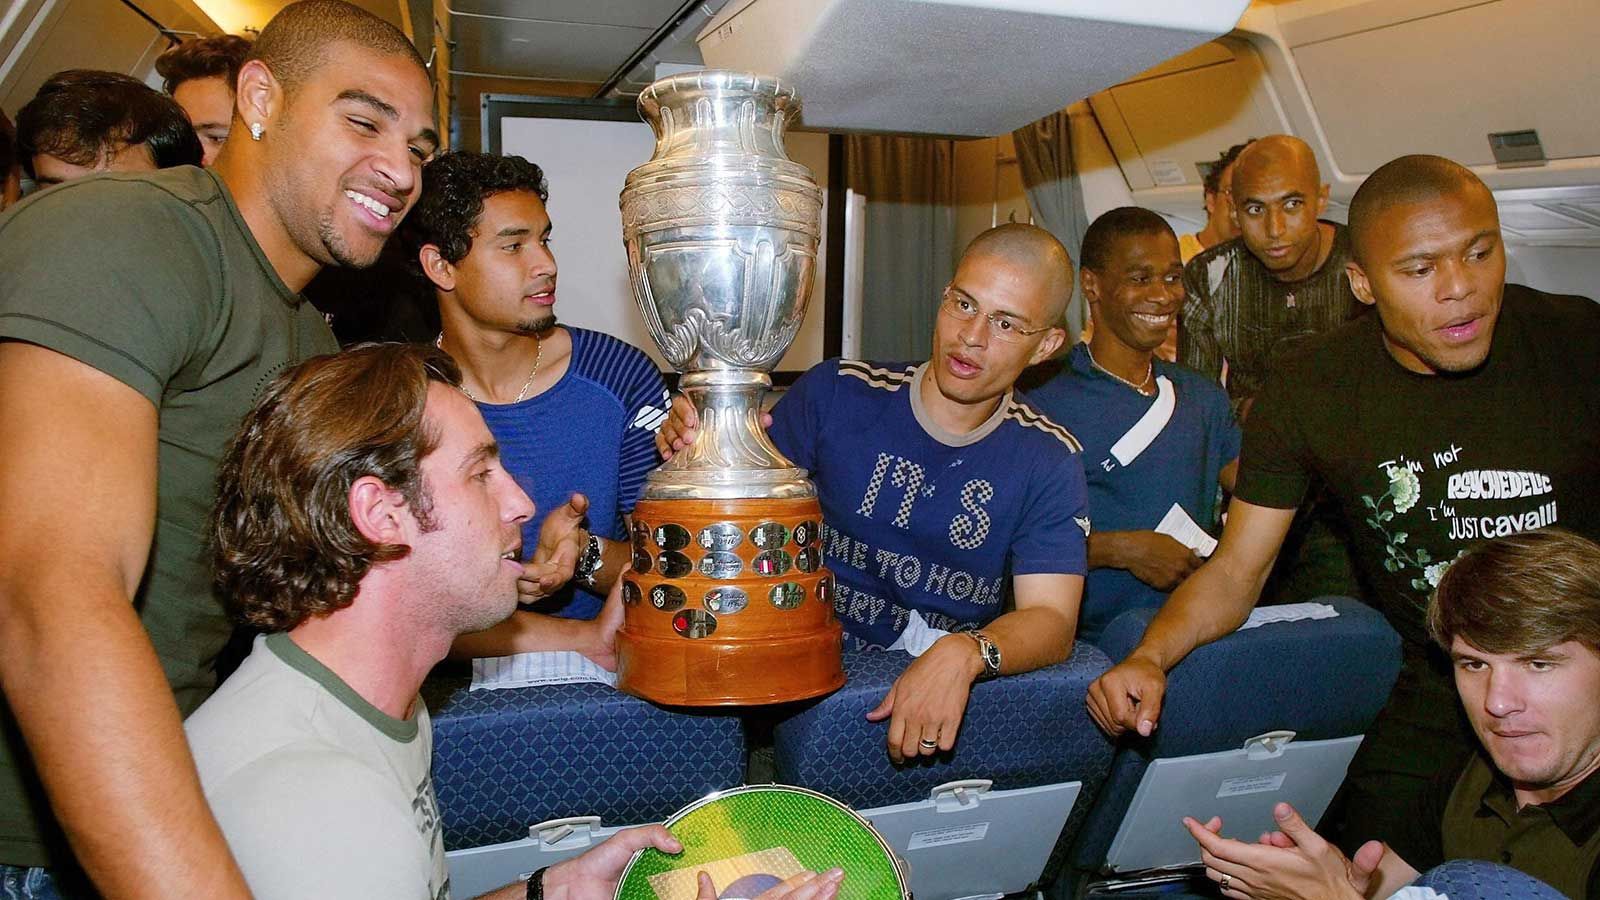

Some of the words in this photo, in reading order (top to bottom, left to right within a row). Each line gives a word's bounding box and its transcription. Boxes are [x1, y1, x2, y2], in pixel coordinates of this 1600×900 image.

[1433, 442, 1463, 469] not
[1448, 470, 1552, 500] PSYCHEDELIC
[1426, 500, 1456, 521] I'm
[1449, 516, 1480, 541] JUST
[1480, 501, 1558, 540] cavalli
[833, 583, 886, 626] ERY
